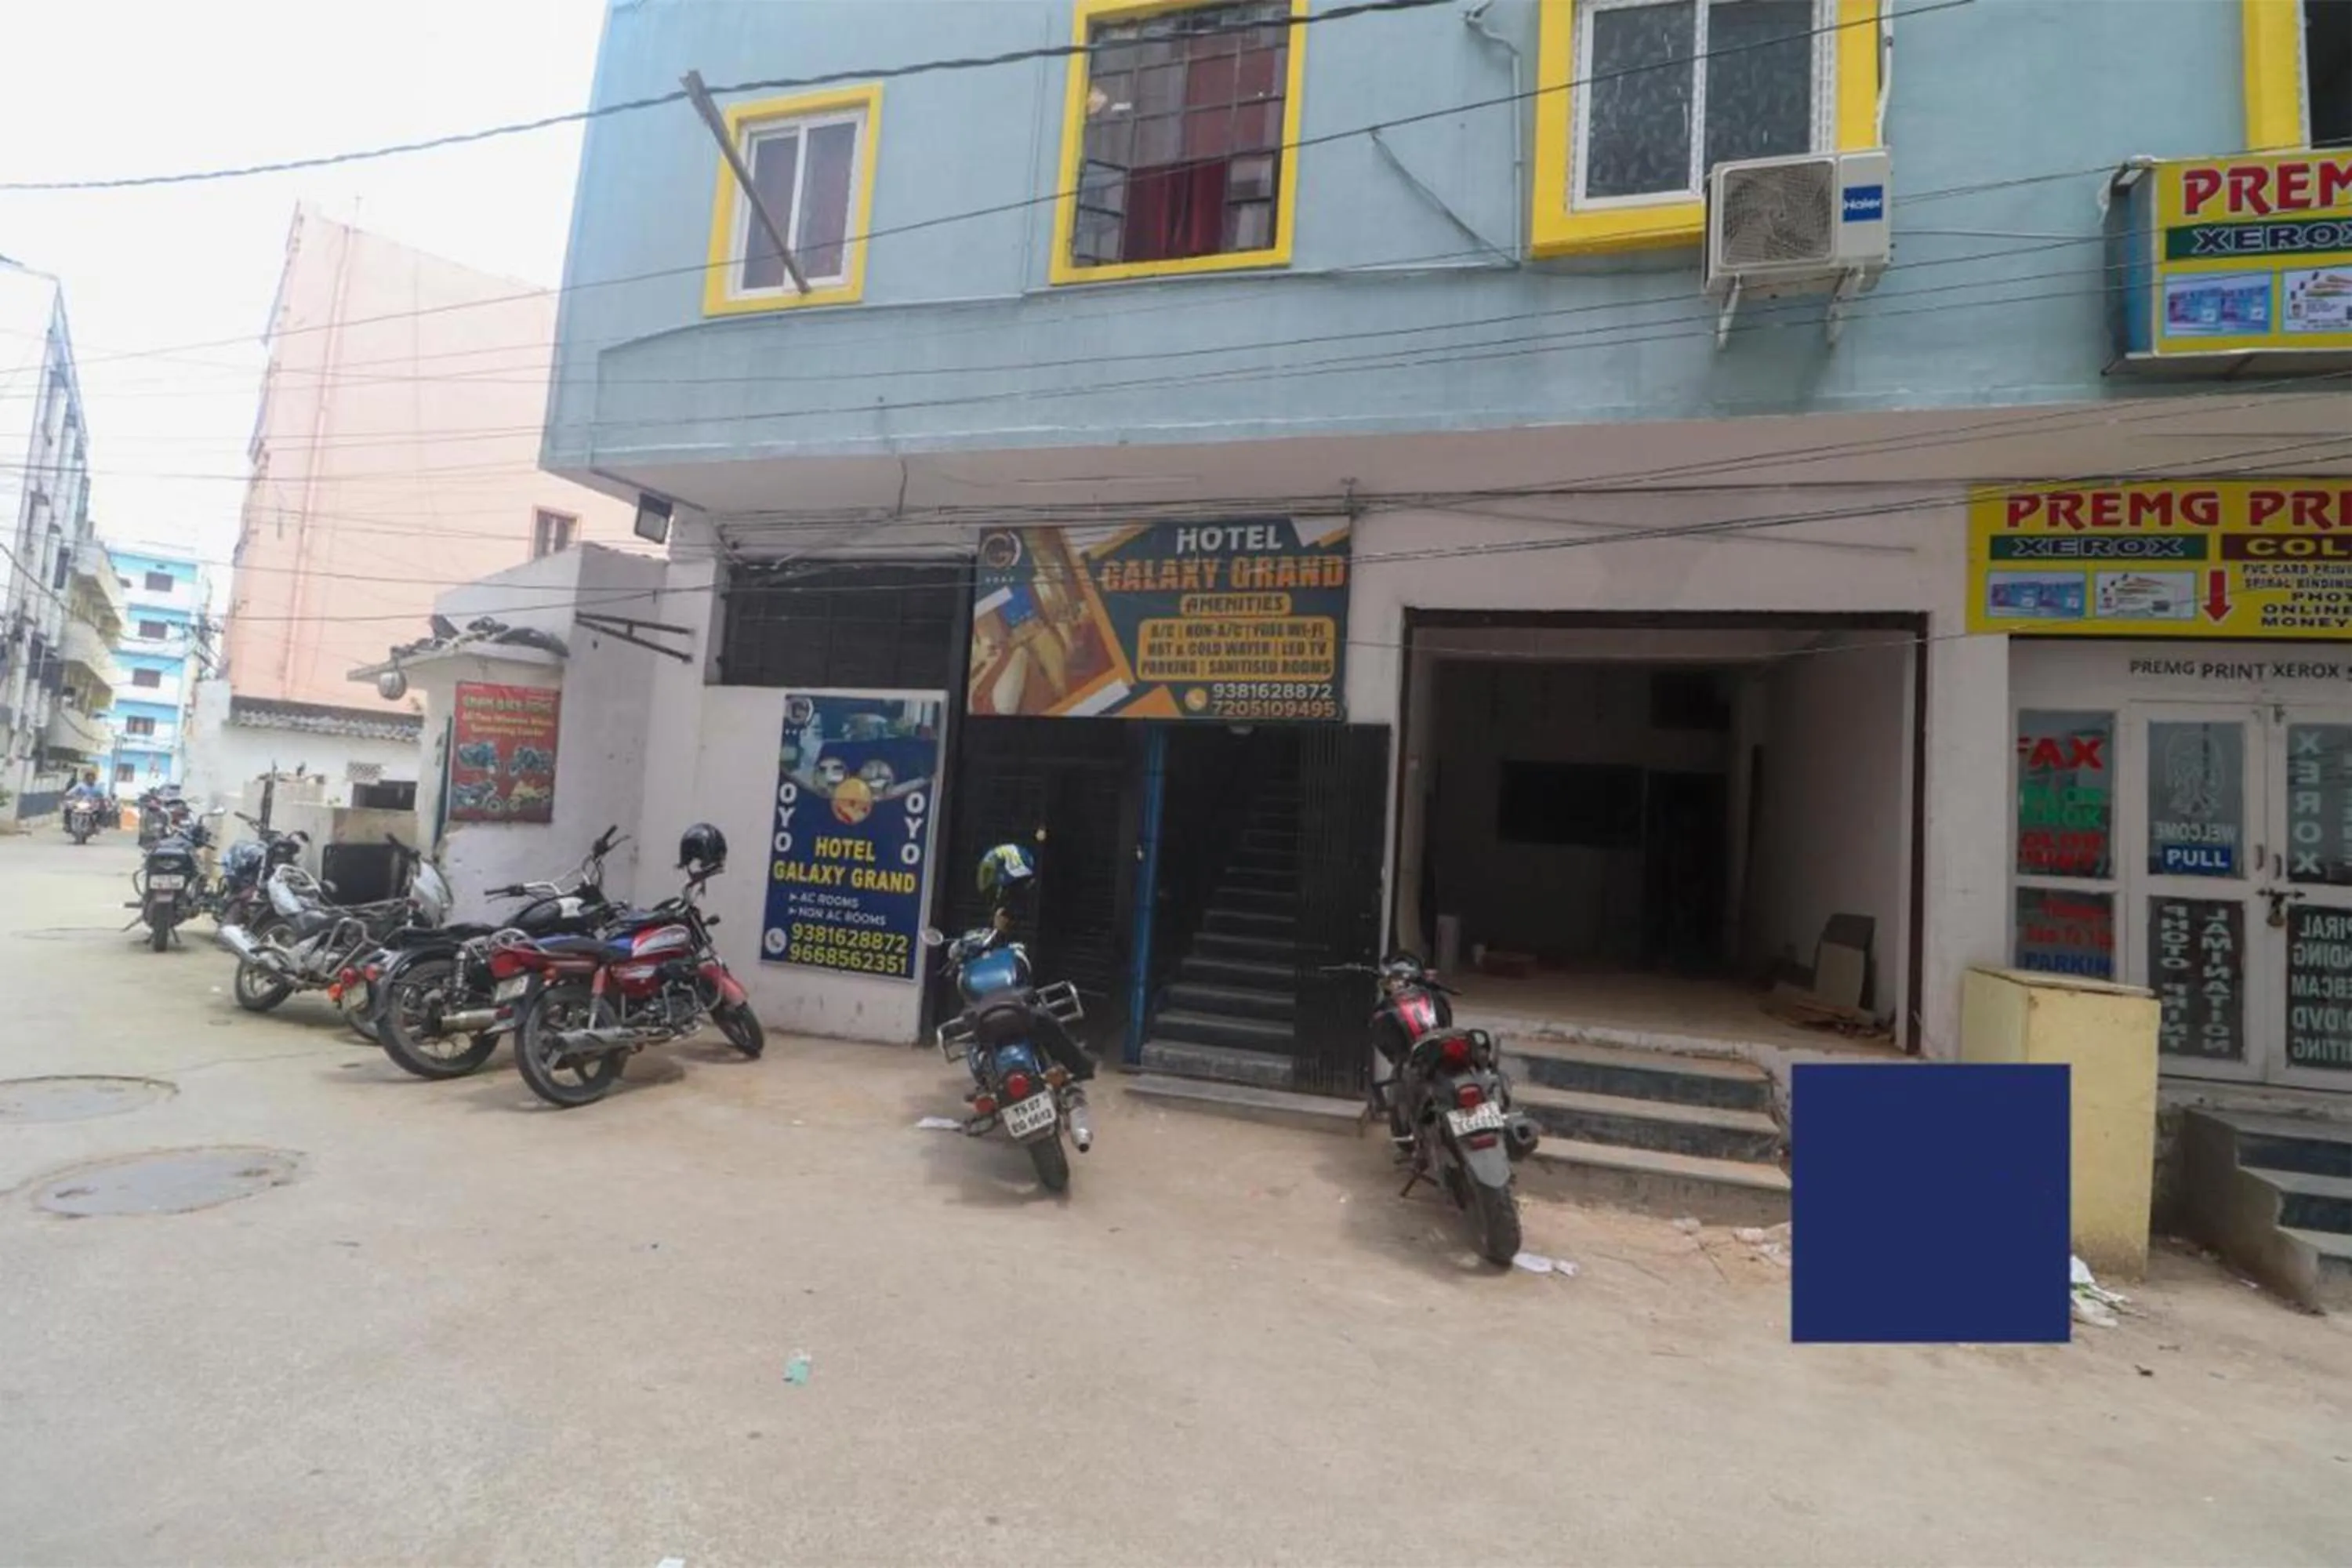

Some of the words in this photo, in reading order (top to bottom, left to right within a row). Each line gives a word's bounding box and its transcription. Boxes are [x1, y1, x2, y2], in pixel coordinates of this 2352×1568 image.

[2007, 491, 2219, 530] PREMG
[1177, 525, 1281, 554] HOTEL
[2012, 537, 2183, 557] XEROX
[2246, 538, 2349, 556] COL
[1102, 559, 1219, 591] GALAXY
[1231, 555, 1345, 587] GRAND
[1185, 595, 1283, 612] AMENITIES
[2261, 617, 2349, 627] MONEY
[1310, 641, 1327, 655] TV
[2129, 659, 2195, 675] PREMG
[2201, 662, 2267, 680] PRINT
[2272, 662, 2339, 679] XEROX
[1212, 683, 1333, 699] 9381628872
[774, 783, 797, 852] OYO
[900, 792, 925, 866] OYO
[815, 836, 876, 862] HOTEL
[2166, 848, 2229, 868] PULL
[773, 860, 845, 886] GALAXY
[851, 868, 916, 894] GRAND
[799, 892, 816, 903] AC
[817, 894, 859, 909] ROOMS
[799, 907, 822, 918] NON
[826, 909, 842, 921] AC
[844, 911, 887, 926] ROOMS
[791, 922, 909, 954] 9381628872
[789, 942, 908, 975] 9668562351
